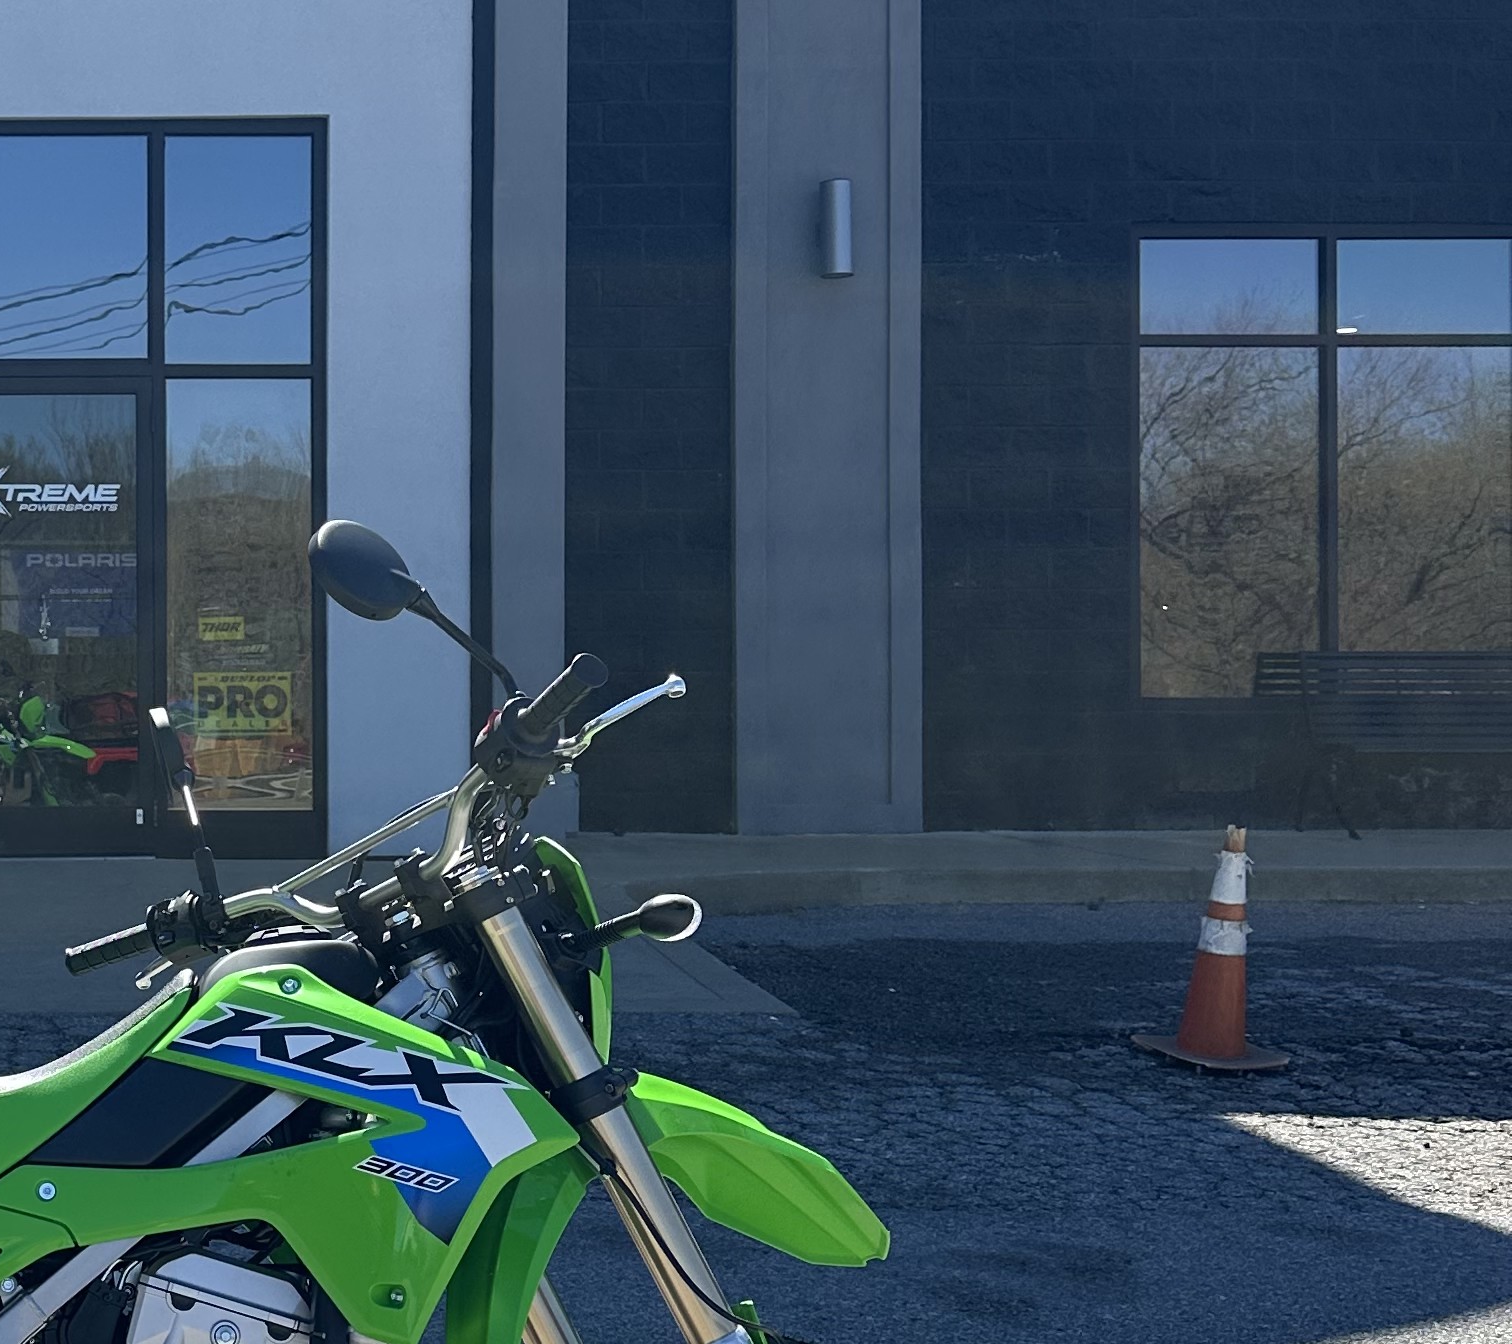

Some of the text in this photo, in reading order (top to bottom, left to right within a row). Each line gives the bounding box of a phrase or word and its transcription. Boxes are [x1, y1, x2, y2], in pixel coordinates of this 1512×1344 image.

[18, 503, 119, 512] POWERSPORTS
[26, 553, 137, 567] POLARIS
[201, 622, 241, 633] THOR
[220, 675, 276, 683] DUNLOP
[197, 684, 288, 718] PRO
[197, 719, 288, 728] DEALER
[172, 1002, 512, 1112] KLX
[354, 1155, 460, 1193] 300
